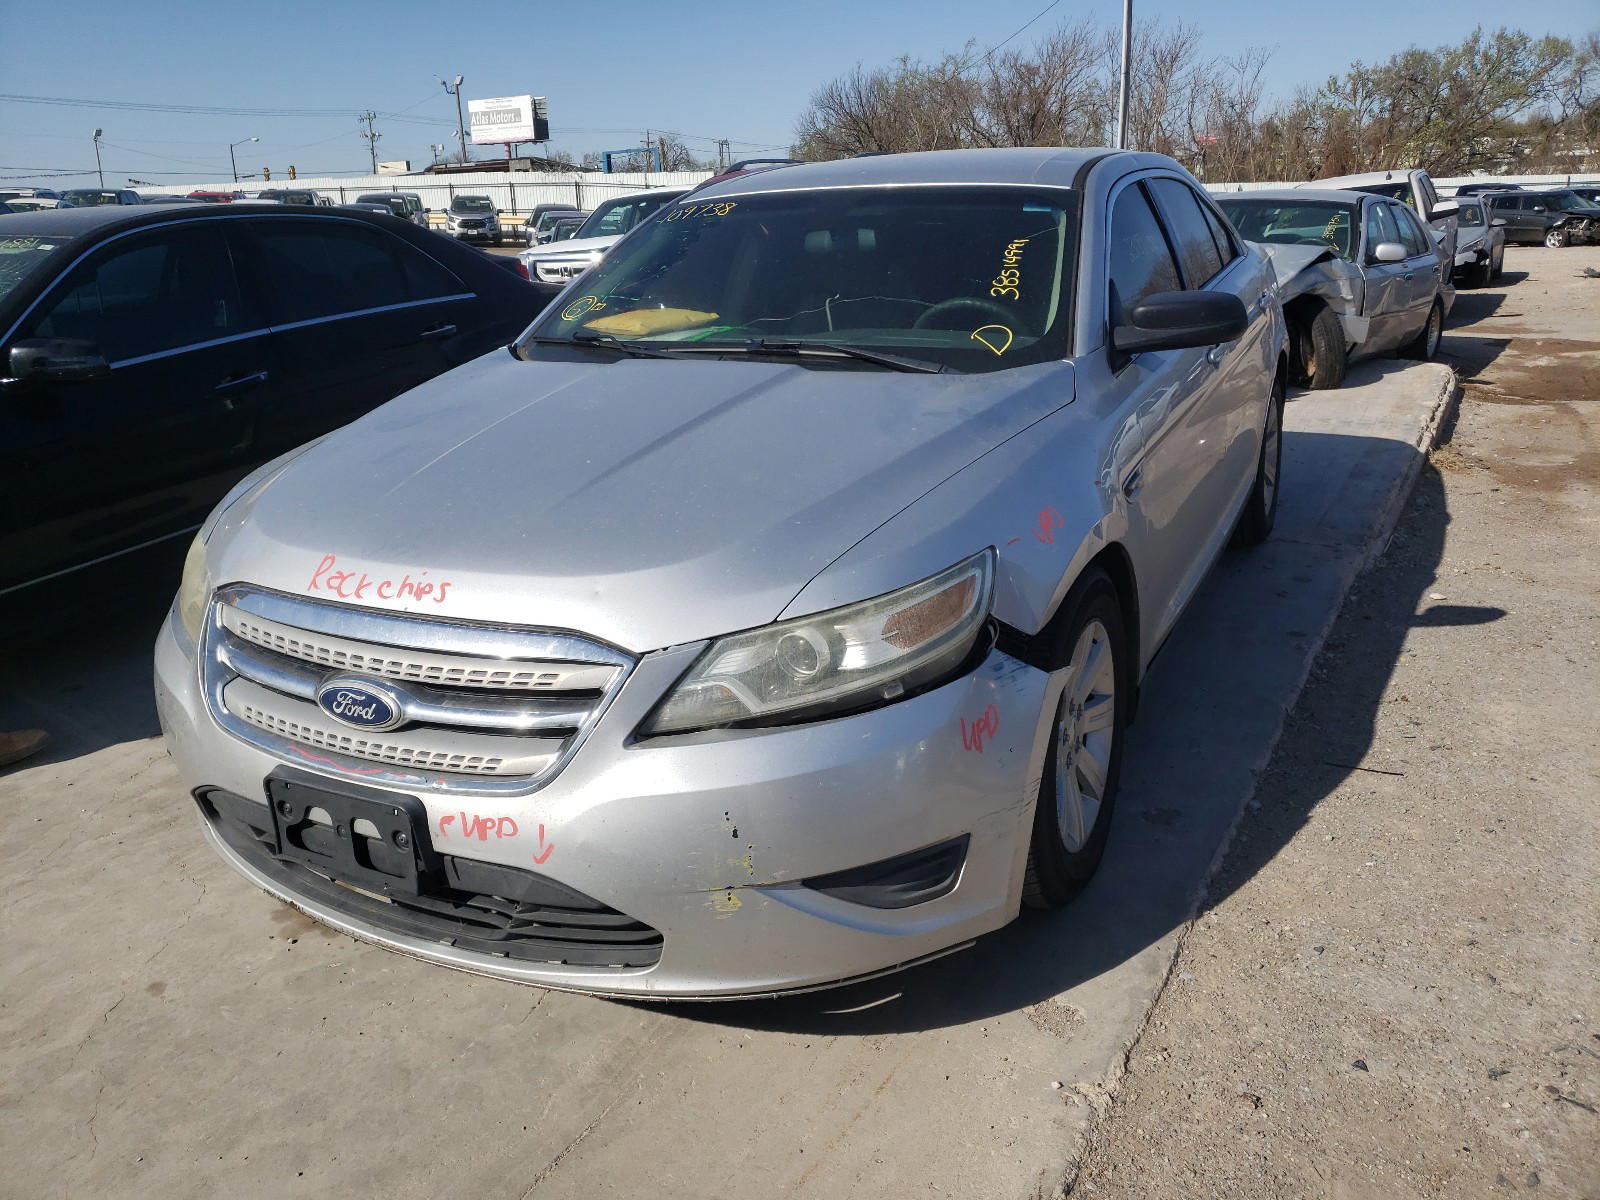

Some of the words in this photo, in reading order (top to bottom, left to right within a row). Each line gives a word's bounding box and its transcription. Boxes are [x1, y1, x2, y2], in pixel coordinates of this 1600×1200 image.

[471, 112, 489, 126] Atlas
[490, 111, 515, 124] Motors
[377, 571, 452, 603] chips
[332, 691, 377, 720] Ford
